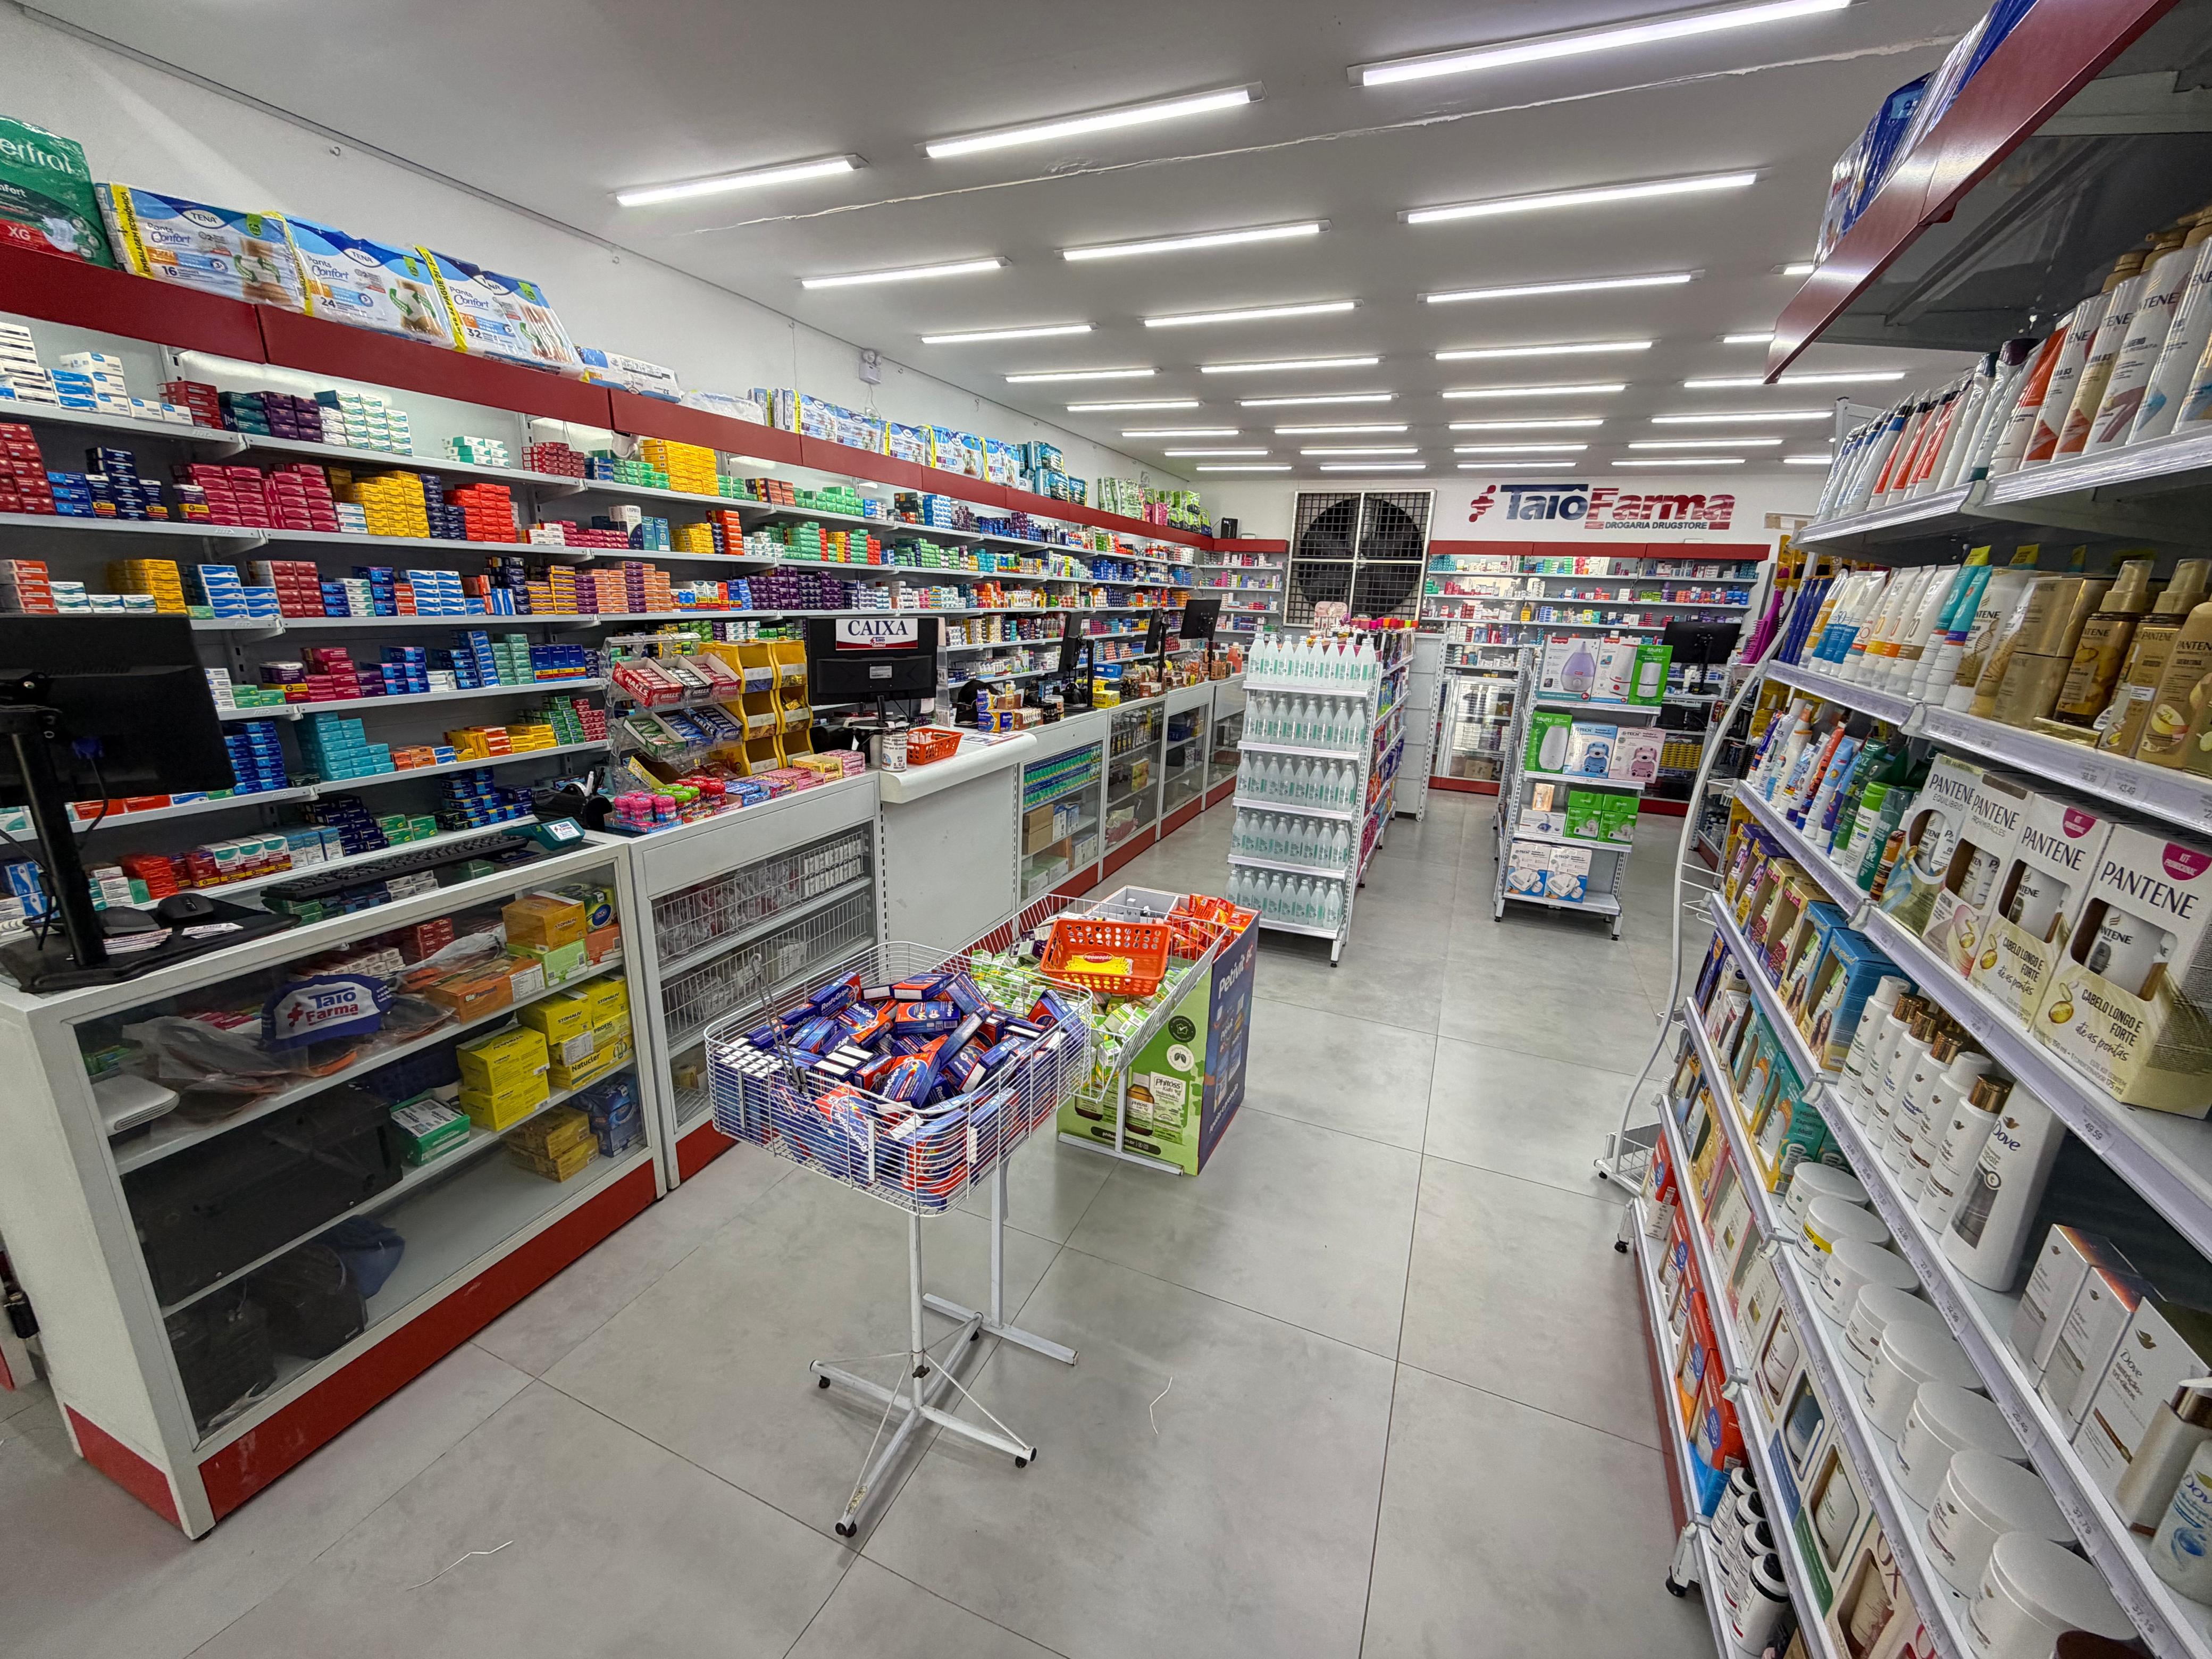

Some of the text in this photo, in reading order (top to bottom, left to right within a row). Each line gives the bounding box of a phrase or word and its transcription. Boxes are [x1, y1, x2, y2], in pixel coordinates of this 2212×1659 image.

[190, 213, 217, 223] TENA
[8, 225, 31, 241] XG
[151, 230, 191, 244] Confort
[132, 234, 151, 273] EMBALAGEM
[351, 251, 373, 263] TENA
[162, 266, 177, 276] 16
[312, 265, 349, 280] Confort
[439, 282, 452, 306] PAGUE
[449, 286, 473, 298] Pants
[320, 297, 336, 308] 24
[454, 295, 489, 310] Confort
[466, 328, 483, 339] 32
[1604, 521, 1708, 530] DROGARIA DRUGSTORE
[848, 619, 909, 636] CAIXA
[2142, 631, 2174, 642] PANTENE
[625, 675, 649, 698] HALLS
[693, 714, 715, 735] HALLS
[1928, 774, 1975, 805] PANTENE
[1971, 794, 2020, 831] PANTENE
[651, 823, 669, 831] mentos
[2021, 826, 2087, 871] PANTENE
[2099, 860, 2200, 920] PANTENE
[555, 917, 577, 929] STOMALIV
[2002, 936, 2045, 970] CABELO LONGO E
[1218, 954, 1246, 1000] Petivit
[2021, 965, 2040, 983] FORTE
[597, 992, 620, 1004] STOMALIV
[820, 987, 850, 1011] ResfeGripe
[305, 1003, 359, 1023] Farma
[557, 1011, 582, 1023] STOMALIV
[851, 1002, 876, 1019] ResfeGripe
[2081, 988, 2144, 1033] CABELO LONGO E
[593, 1020, 613, 1034] PROFIG
[2109, 1023, 2138, 1047] FORTE
[2095, 1037, 2130, 1062] pontas
[571, 1052, 601, 1073] Natucler
[1992, 1120, 2021, 1152] Dove
[2119, 1348, 2143, 1378] Dove
